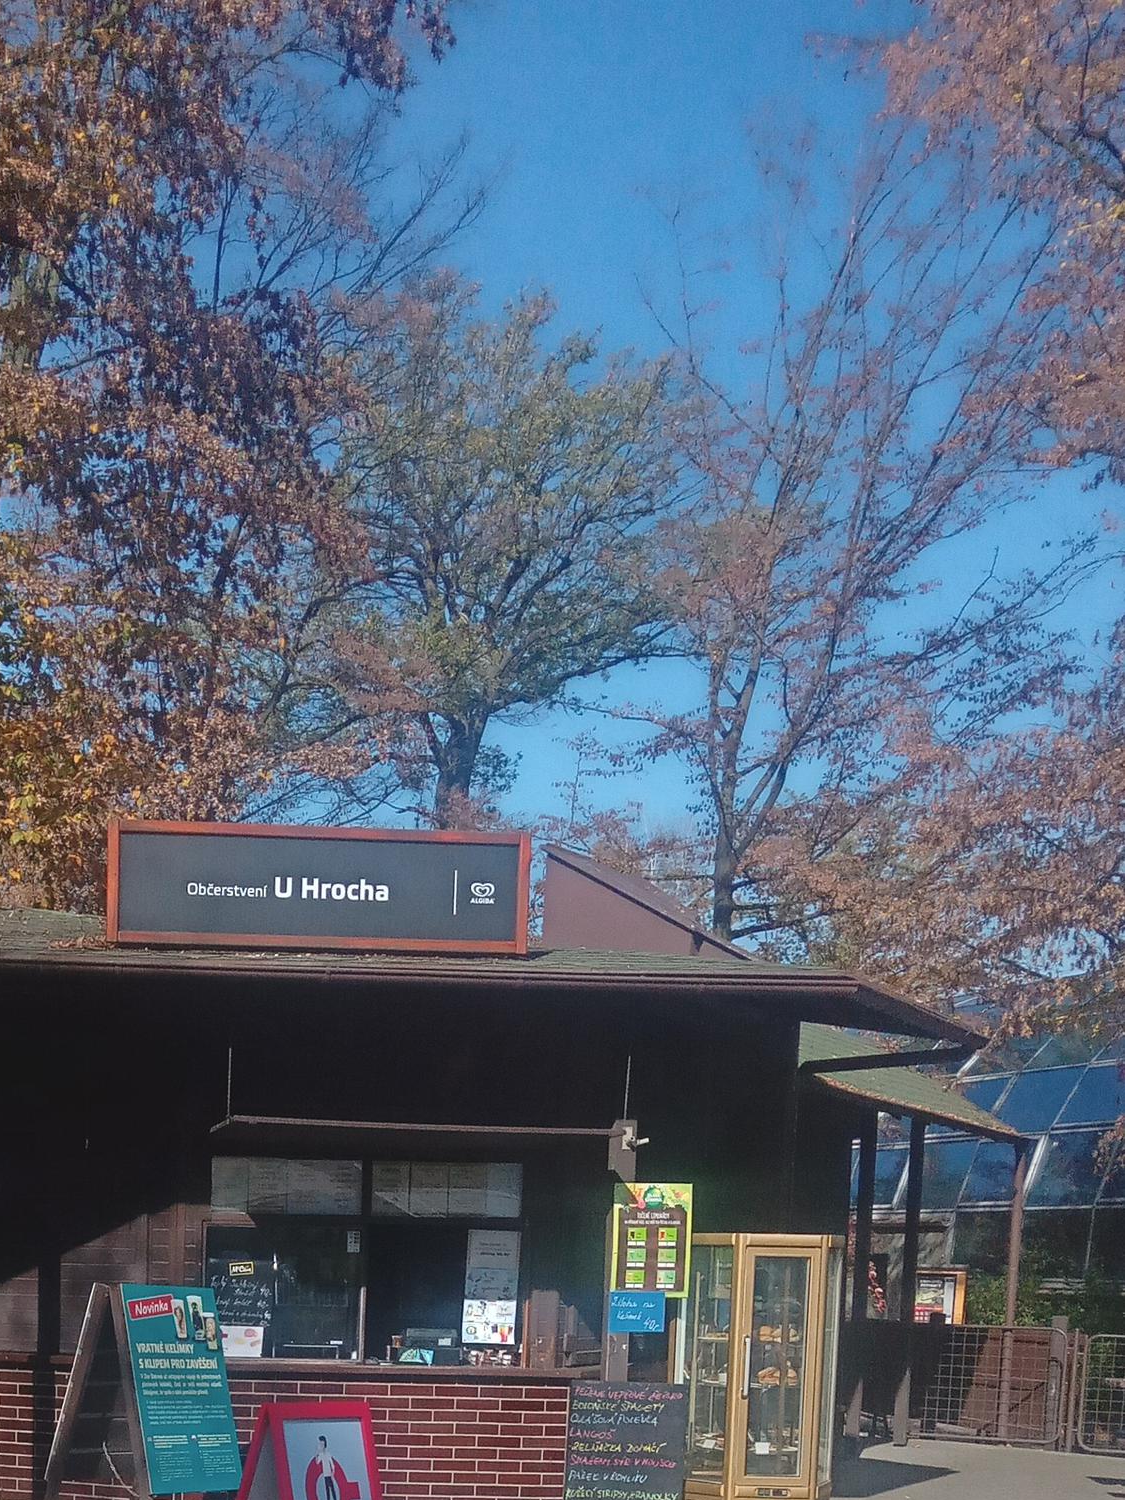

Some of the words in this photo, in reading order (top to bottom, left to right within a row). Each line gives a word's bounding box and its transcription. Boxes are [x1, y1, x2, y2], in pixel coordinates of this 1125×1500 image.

[186, 880, 268, 899] Občerstvení
[273, 876, 293, 899] U
[301, 876, 390, 902] Hrocha
[470, 897, 495, 905] ALGIDA
[135, 1300, 169, 1316] Novinka
[136, 1341, 165, 1354] VRATNÉ
[165, 1342, 194, 1354] KELÍMKY
[138, 1358, 144, 1369] S
[145, 1359, 171, 1369] KLIPEM
[172, 1358, 186, 1369] PRO
[186, 1356, 218, 1369] ZAVĚŠENÍ
[569, 1427, 617, 1439] LANGOŠ
